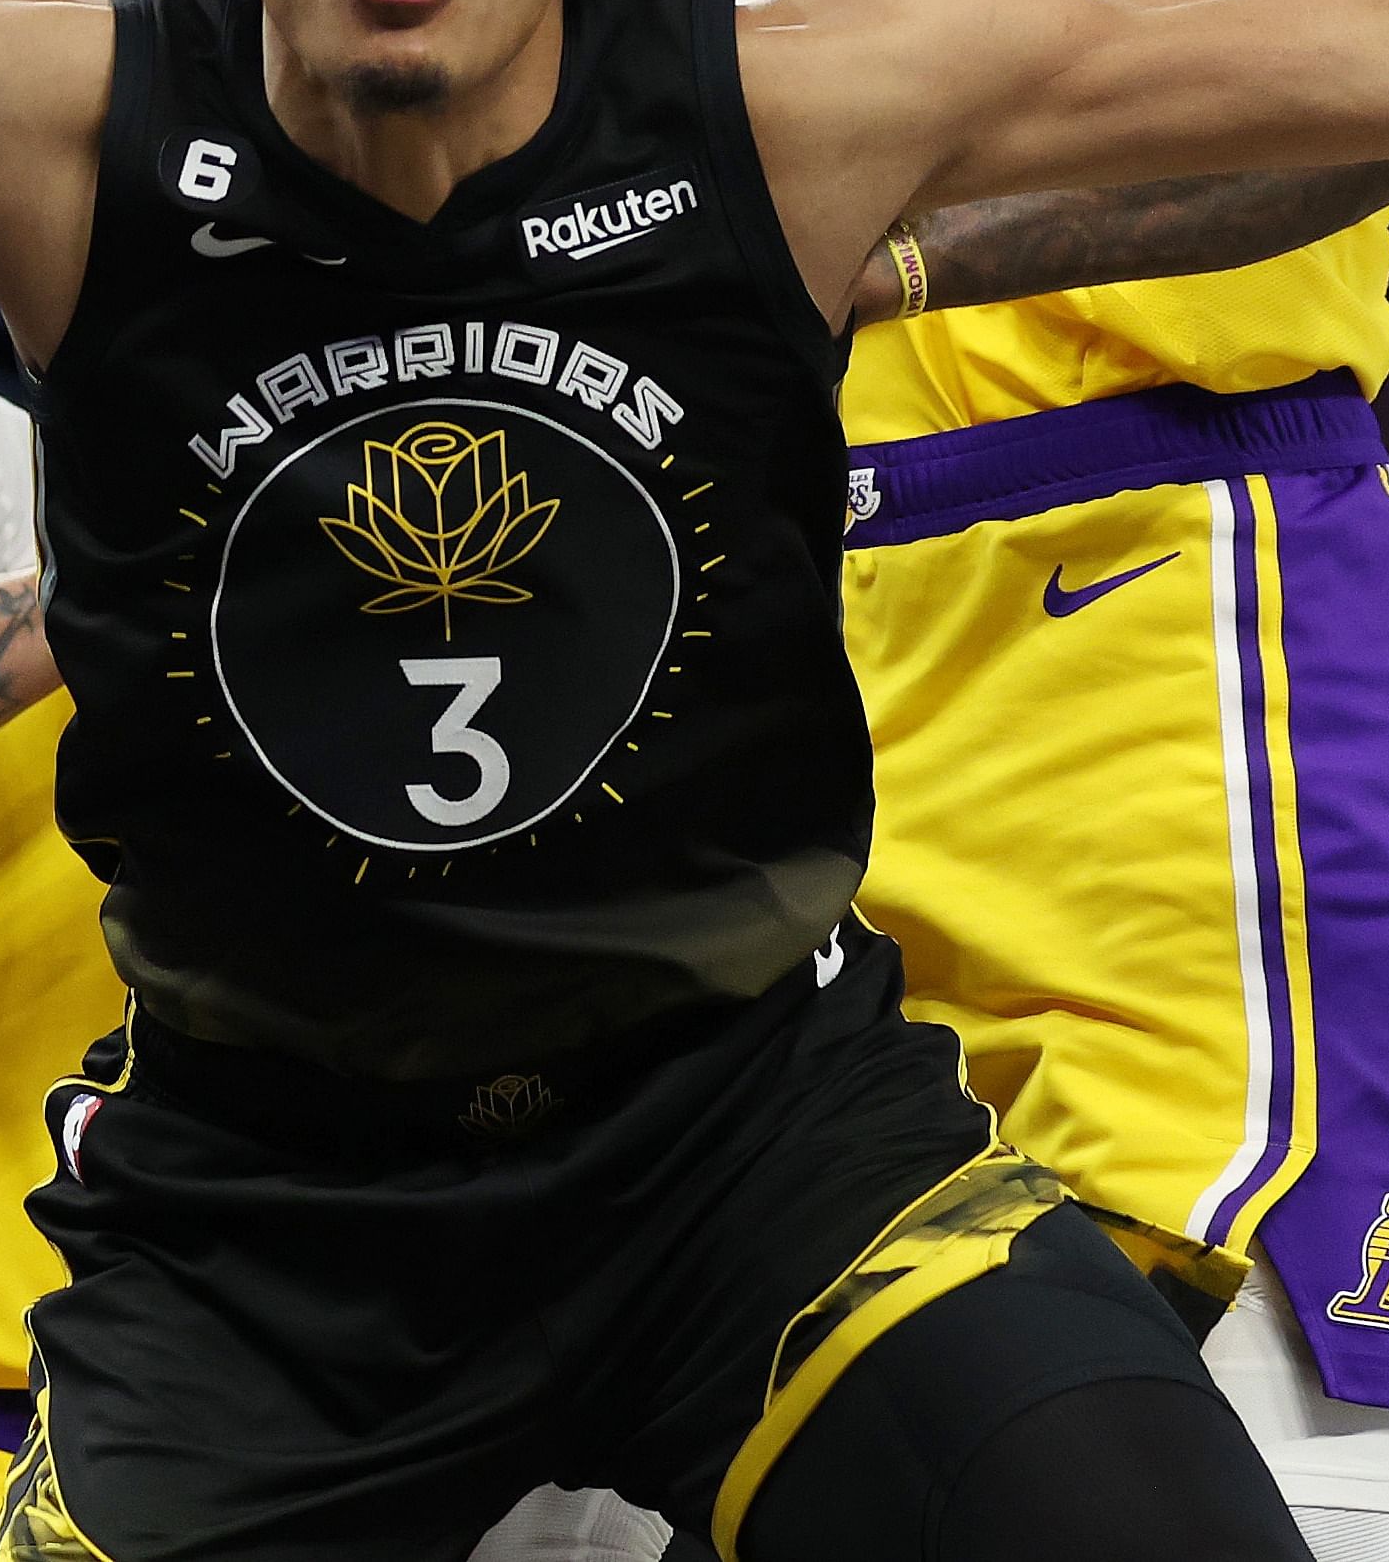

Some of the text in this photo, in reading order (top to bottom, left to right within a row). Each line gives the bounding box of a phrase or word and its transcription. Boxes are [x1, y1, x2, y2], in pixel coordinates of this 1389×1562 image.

[178, 138, 238, 202] 6
[521, 180, 698, 259] Rakuten
[187, 322, 685, 479] WARRIORS
[399, 657, 510, 827] 3
